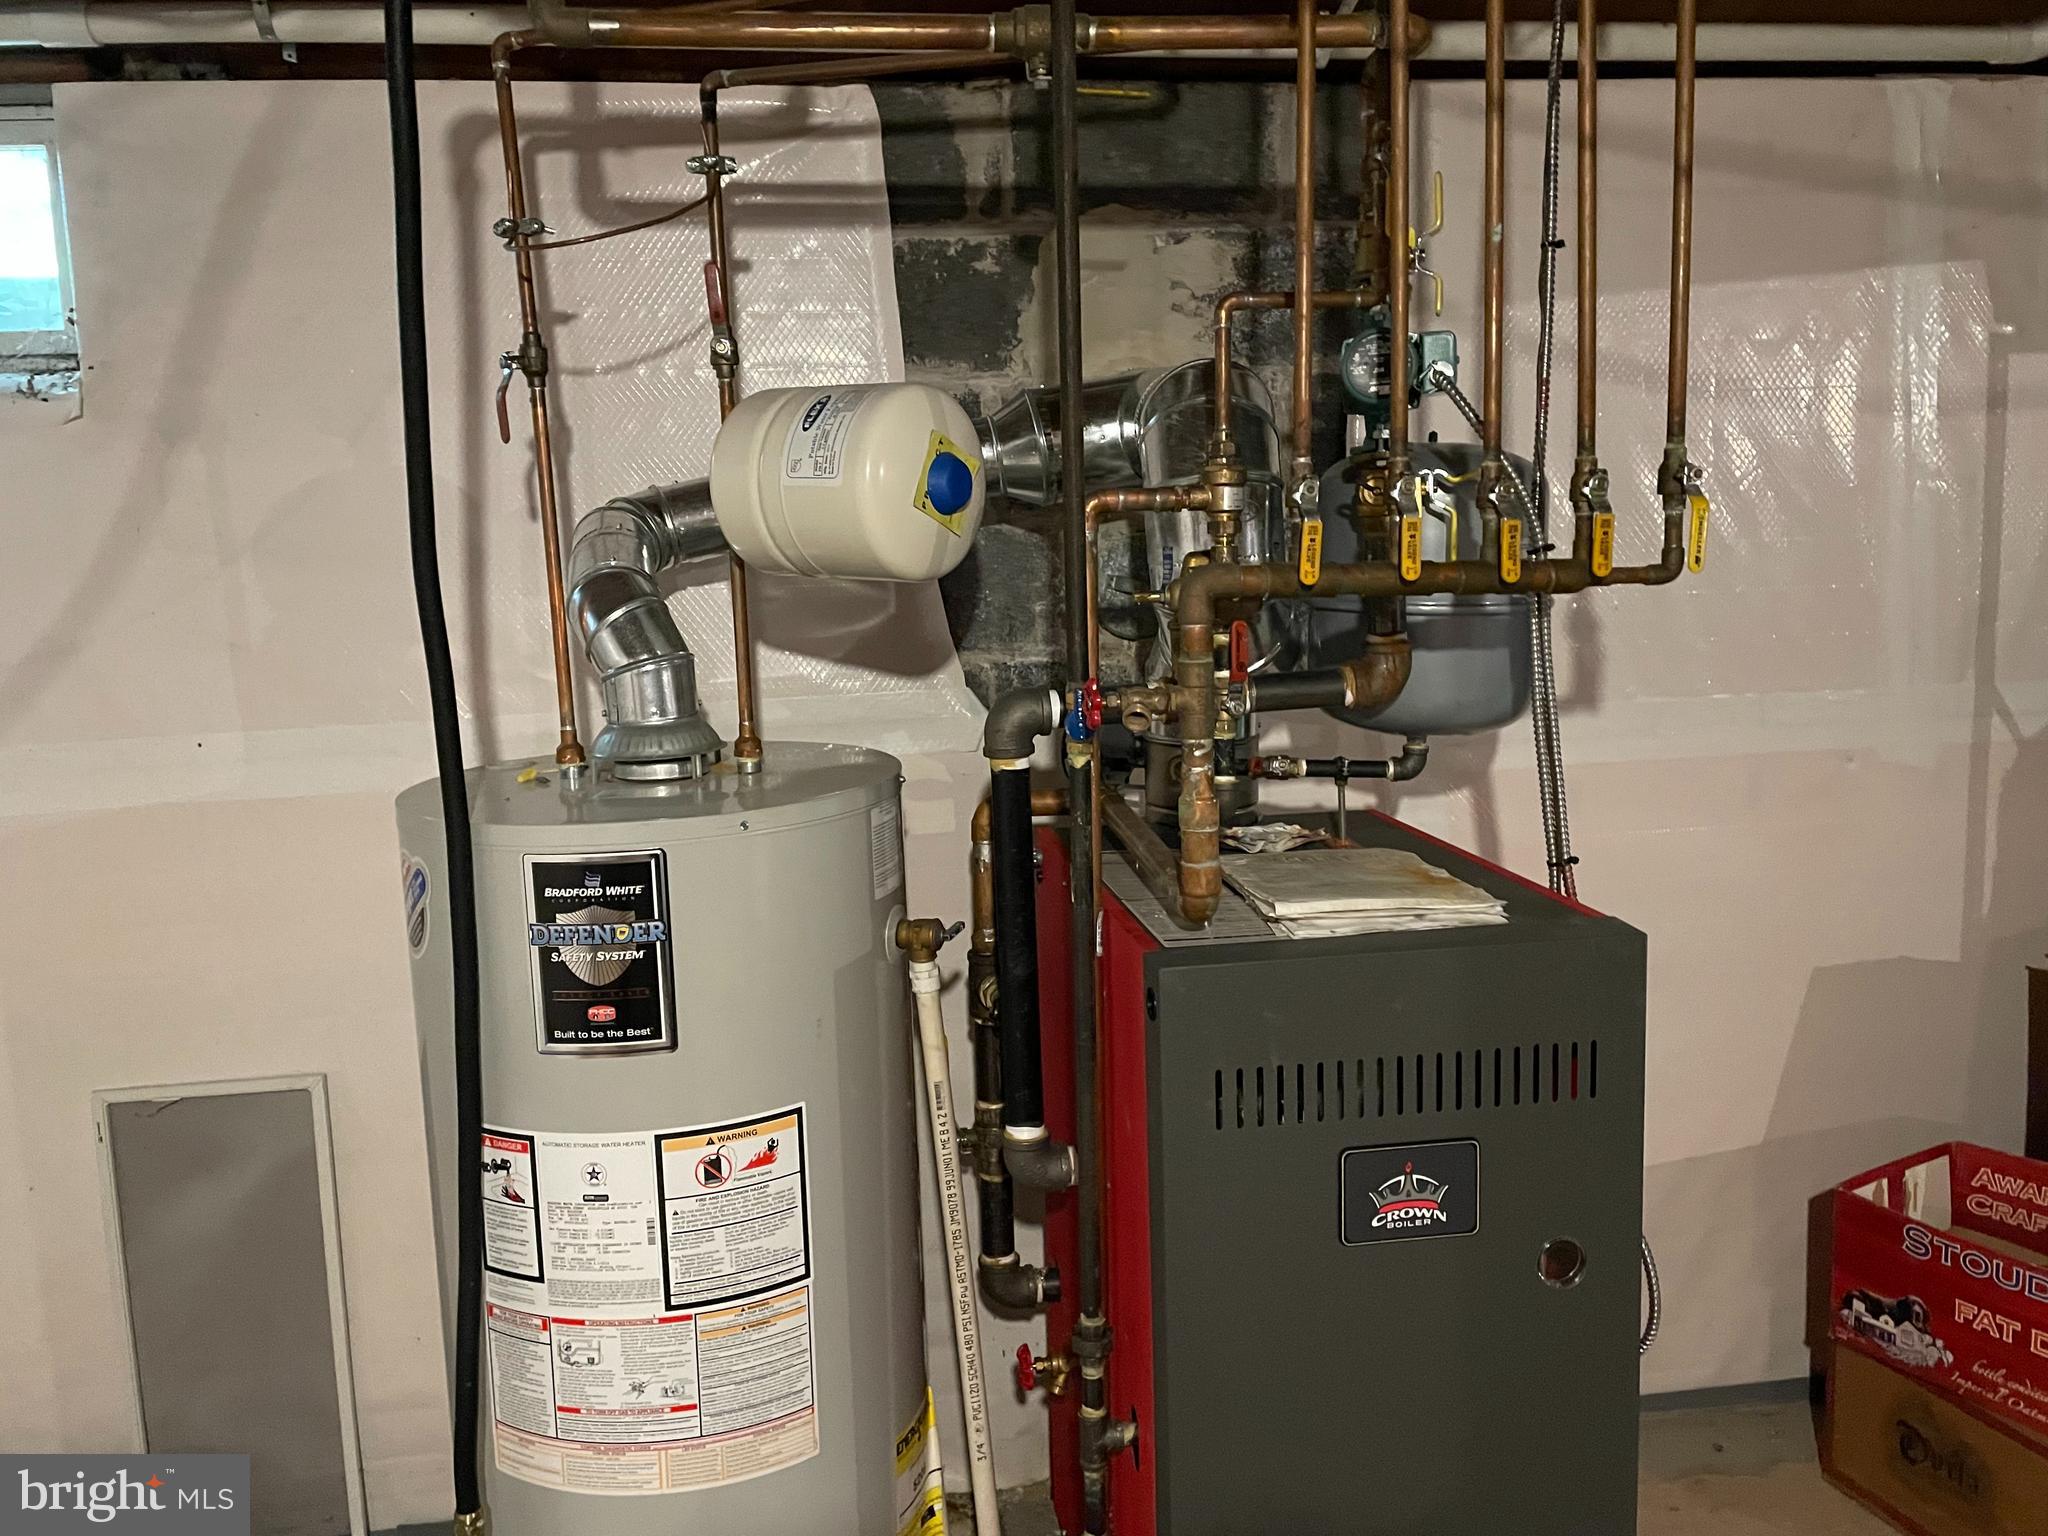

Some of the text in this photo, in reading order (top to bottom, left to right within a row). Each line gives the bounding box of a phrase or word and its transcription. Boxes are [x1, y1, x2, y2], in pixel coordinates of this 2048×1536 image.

[544, 885, 644, 898] BRADFORD WHITE
[530, 921, 667, 947] DEFENDER
[550, 950, 644, 963] SAFETY SYSTEM
[554, 1028, 651, 1039] Built to be the Best
[716, 1128, 758, 1143] WARNING
[492, 1139, 522, 1151] DANGER
[1371, 1207, 1447, 1228] CROWN
[1386, 1218, 1432, 1229] BOILER
[962, 1316, 973, 1332] PSI
[1955, 1298, 2021, 1344] FAT
[966, 1353, 978, 1381] SCH40
